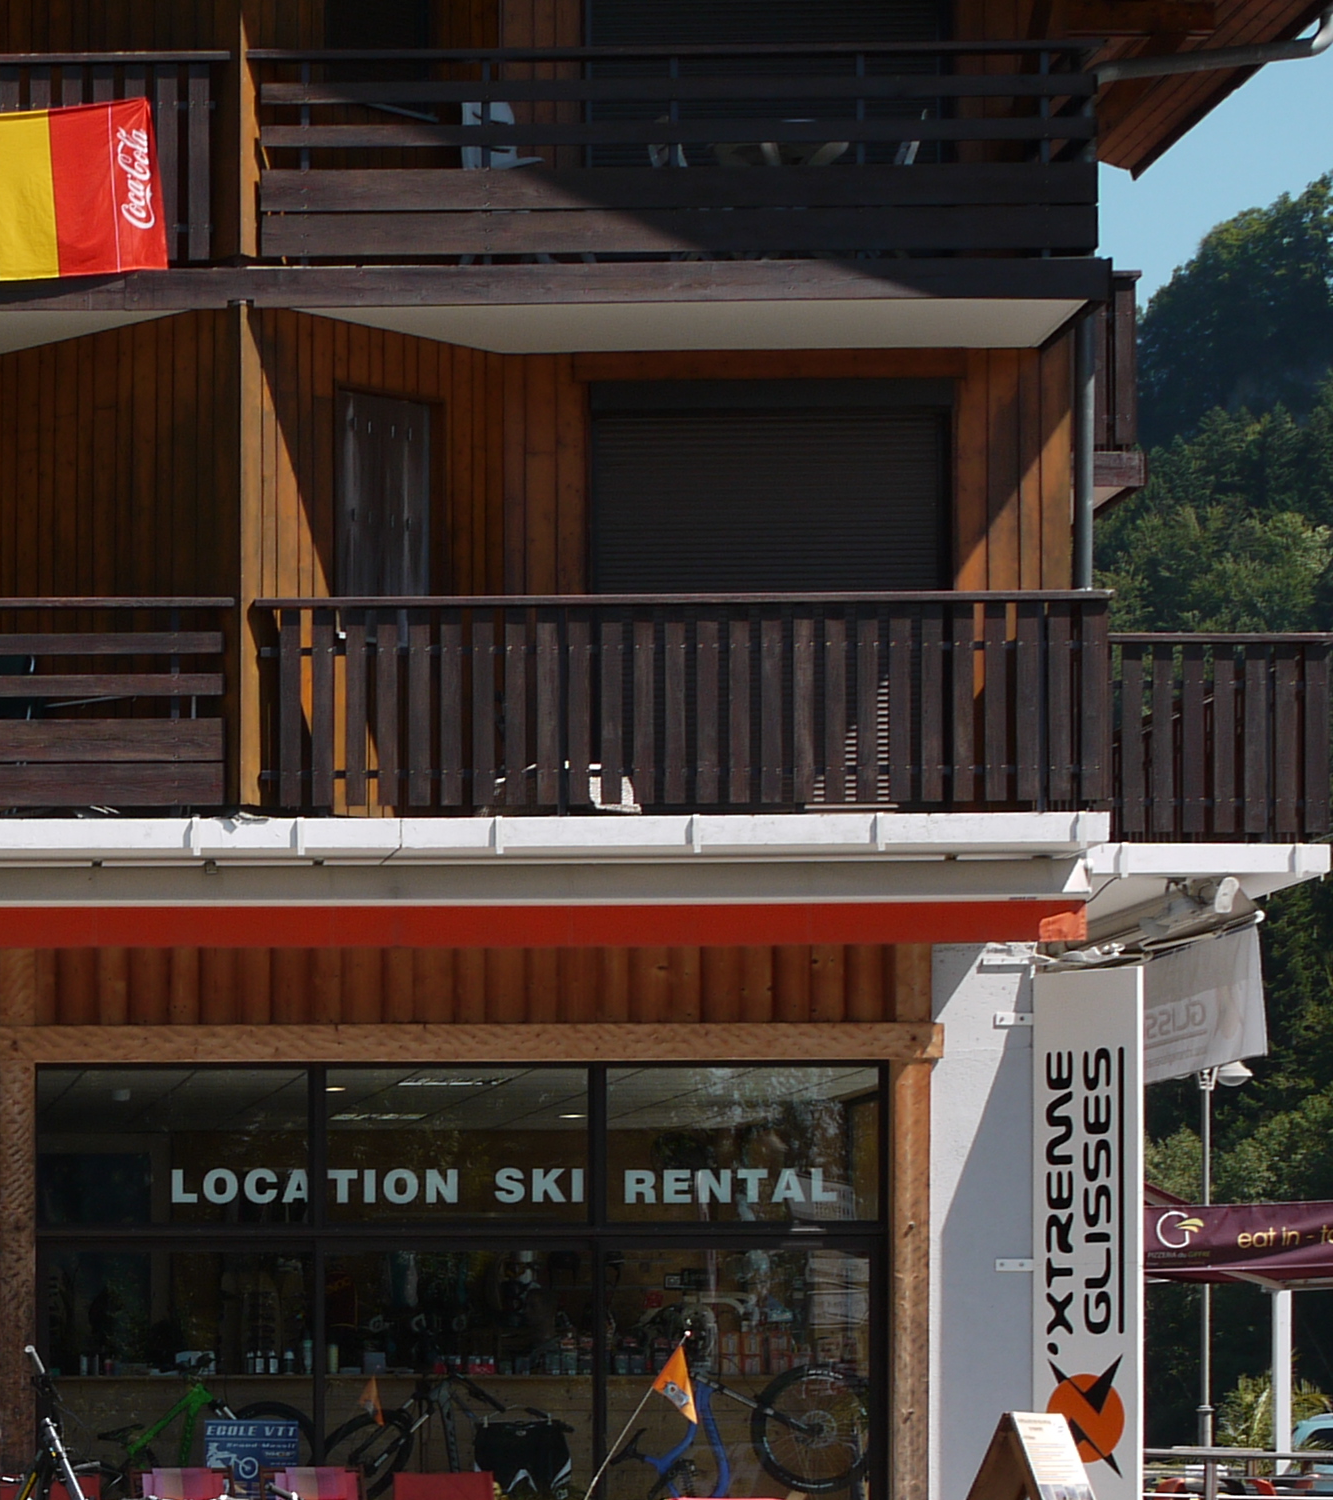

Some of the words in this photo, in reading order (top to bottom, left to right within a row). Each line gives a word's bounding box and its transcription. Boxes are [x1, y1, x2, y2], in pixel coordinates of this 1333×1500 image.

[493, 1168, 585, 1204] SKI
[623, 1168, 839, 1204] RENTAL
[1082, 1046, 1112, 1335] GLISSES
[1237, 1226, 1276, 1249] eat
[1282, 1226, 1300, 1246] in
[206, 1425, 258, 1437] ECOLE
[263, 1425, 298, 1437] VTT
